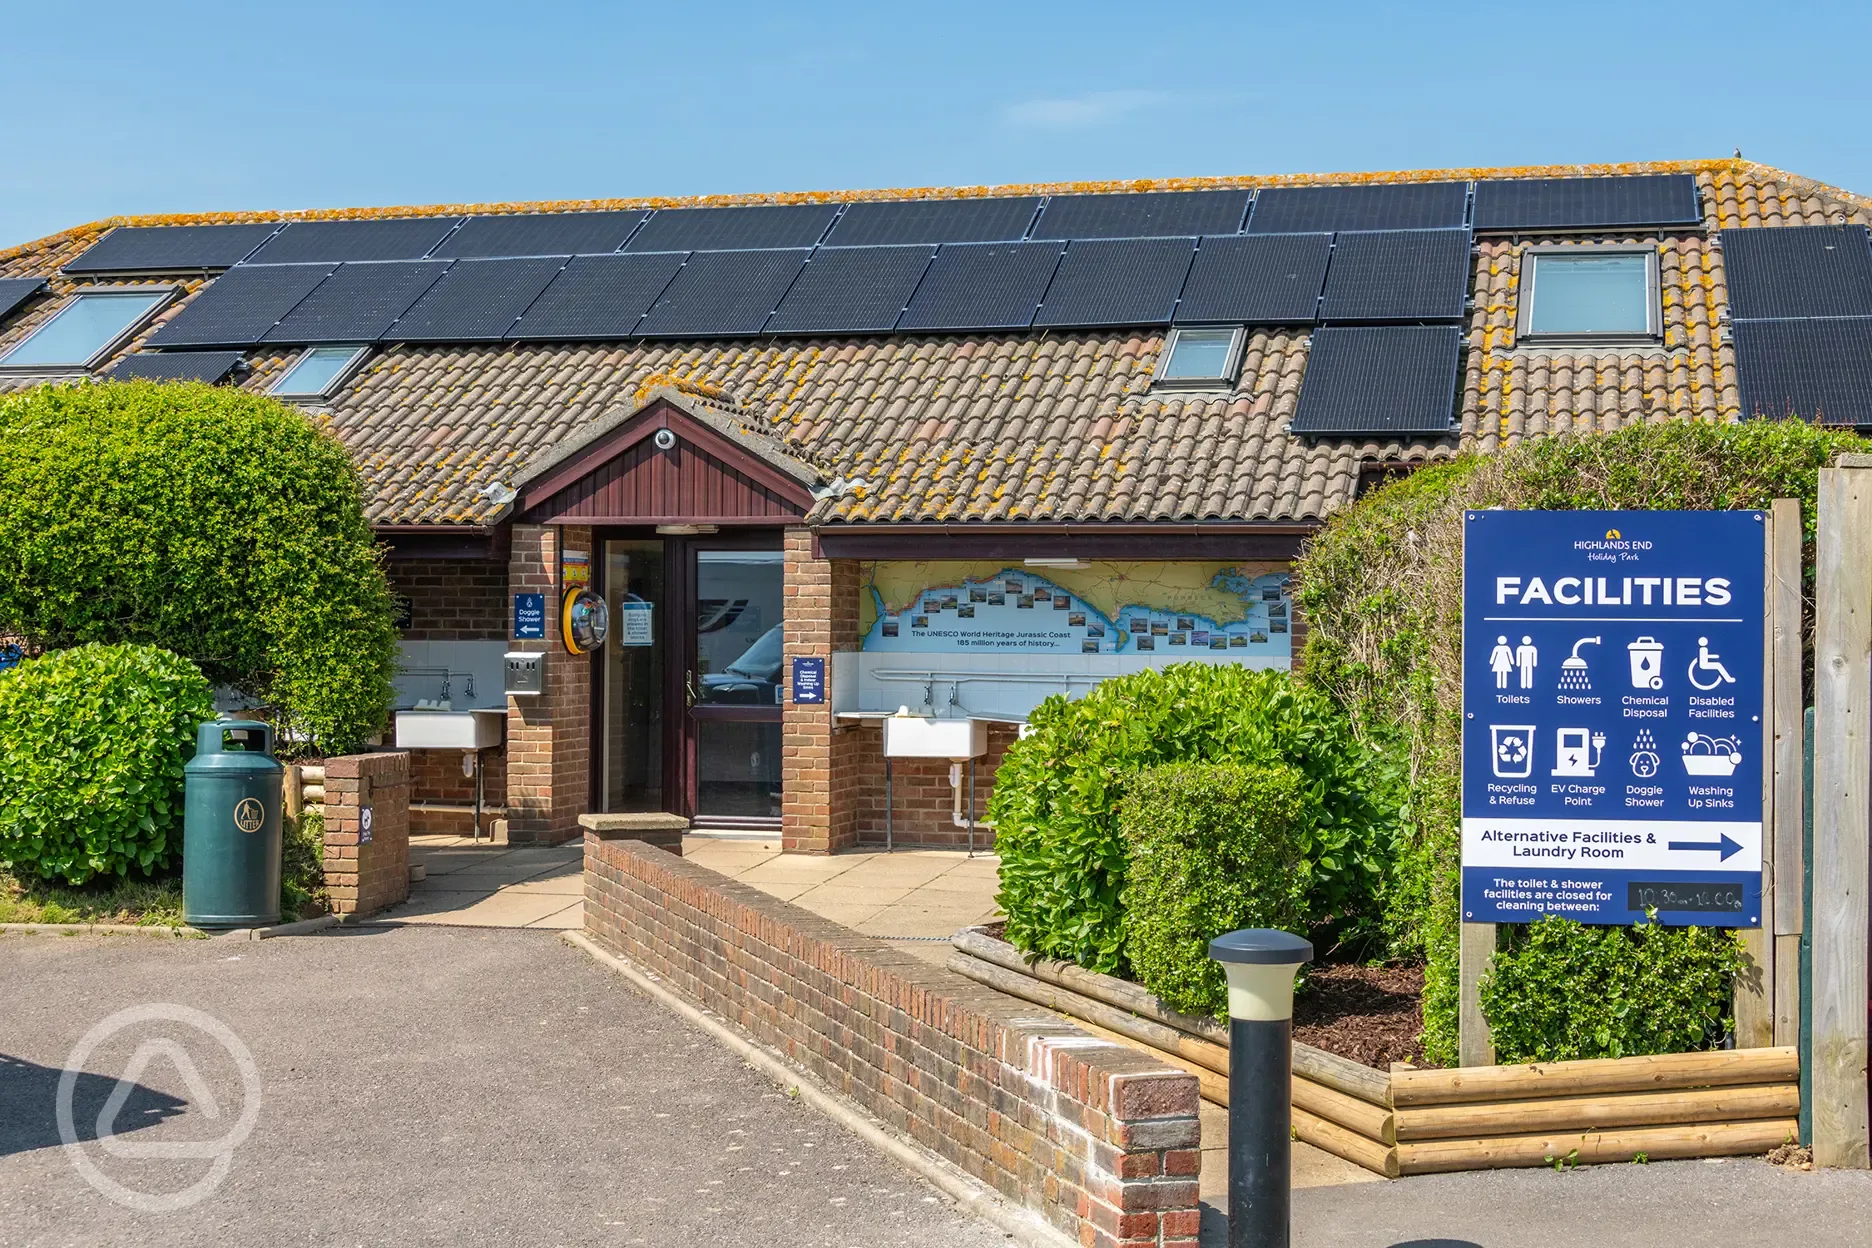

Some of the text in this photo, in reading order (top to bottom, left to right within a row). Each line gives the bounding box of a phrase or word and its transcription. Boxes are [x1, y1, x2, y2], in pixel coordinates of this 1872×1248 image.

[1574, 541, 1652, 550] HIGHLANDS END
[1587, 552, 1640, 563] Holiday Park
[1496, 576, 1732, 605] FACILITIES
[1496, 695, 1530, 704] Toilets
[1556, 696, 1601, 705] Showers
[1622, 696, 1668, 706] Chemical
[1689, 697, 1734, 706] Disabled
[1623, 708, 1668, 718] Disposal
[1689, 709, 1734, 718] Facilities
[1488, 784, 1537, 795] Recycling
[1552, 784, 1606, 796] EV Charge
[1626, 785, 1663, 797] Doggie
[1688, 786, 1733, 797] Washing
[1490, 796, 1535, 805] & Refuse
[1564, 797, 1592, 806] Point
[1625, 798, 1664, 807] Shower
[1688, 798, 1734, 810] Up Sinks
[240, 819, 260, 829] LITTER
[1482, 830, 1656, 844] Alternative Facilities &
[1514, 846, 1624, 860] Laundry Room
[1494, 879, 1602, 889] The toilet & shower
[1484, 890, 1612, 900] facilities are closed for
[1496, 901, 1600, 913] cleaning between:
